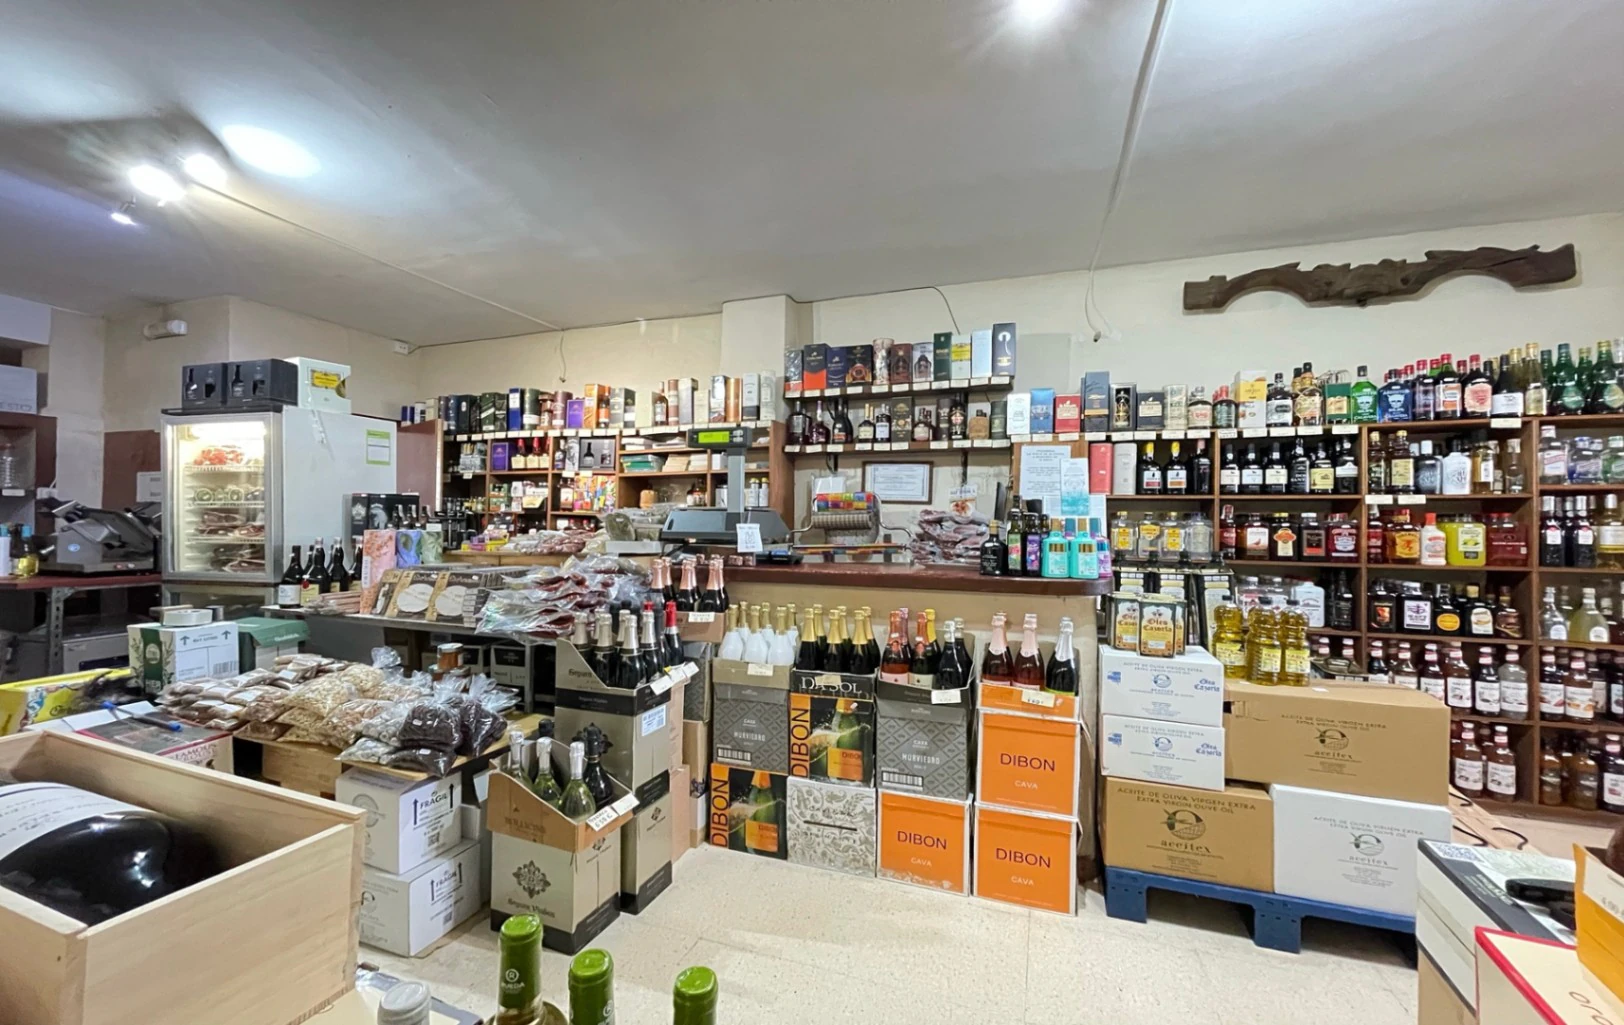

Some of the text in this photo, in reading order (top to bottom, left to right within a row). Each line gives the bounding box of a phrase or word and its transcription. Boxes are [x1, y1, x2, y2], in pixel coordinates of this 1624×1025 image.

[792, 708, 810, 777] DIBON
[902, 753, 940, 765] MURVIEDRO
[1000, 753, 1055, 772] DIBON
[1014, 780, 1038, 790] CAVA
[1117, 788, 1145, 796] ACEITE
[1162, 793, 1188, 801] OLIVA
[1191, 796, 1225, 806] VIRGEN
[1228, 801, 1256, 811] EXTRA
[1136, 795, 1160, 804] EXTRA
[1163, 799, 1191, 808] VIRGIN
[1194, 803, 1217, 812] OLIVE
[711, 778, 729, 847] DIBON
[897, 830, 947, 850] DIBON
[1161, 839, 1211, 854] aceitex
[910, 856, 932, 867] CAVA
[995, 847, 1051, 869] DIBON
[1010, 875, 1034, 886] CAVA
